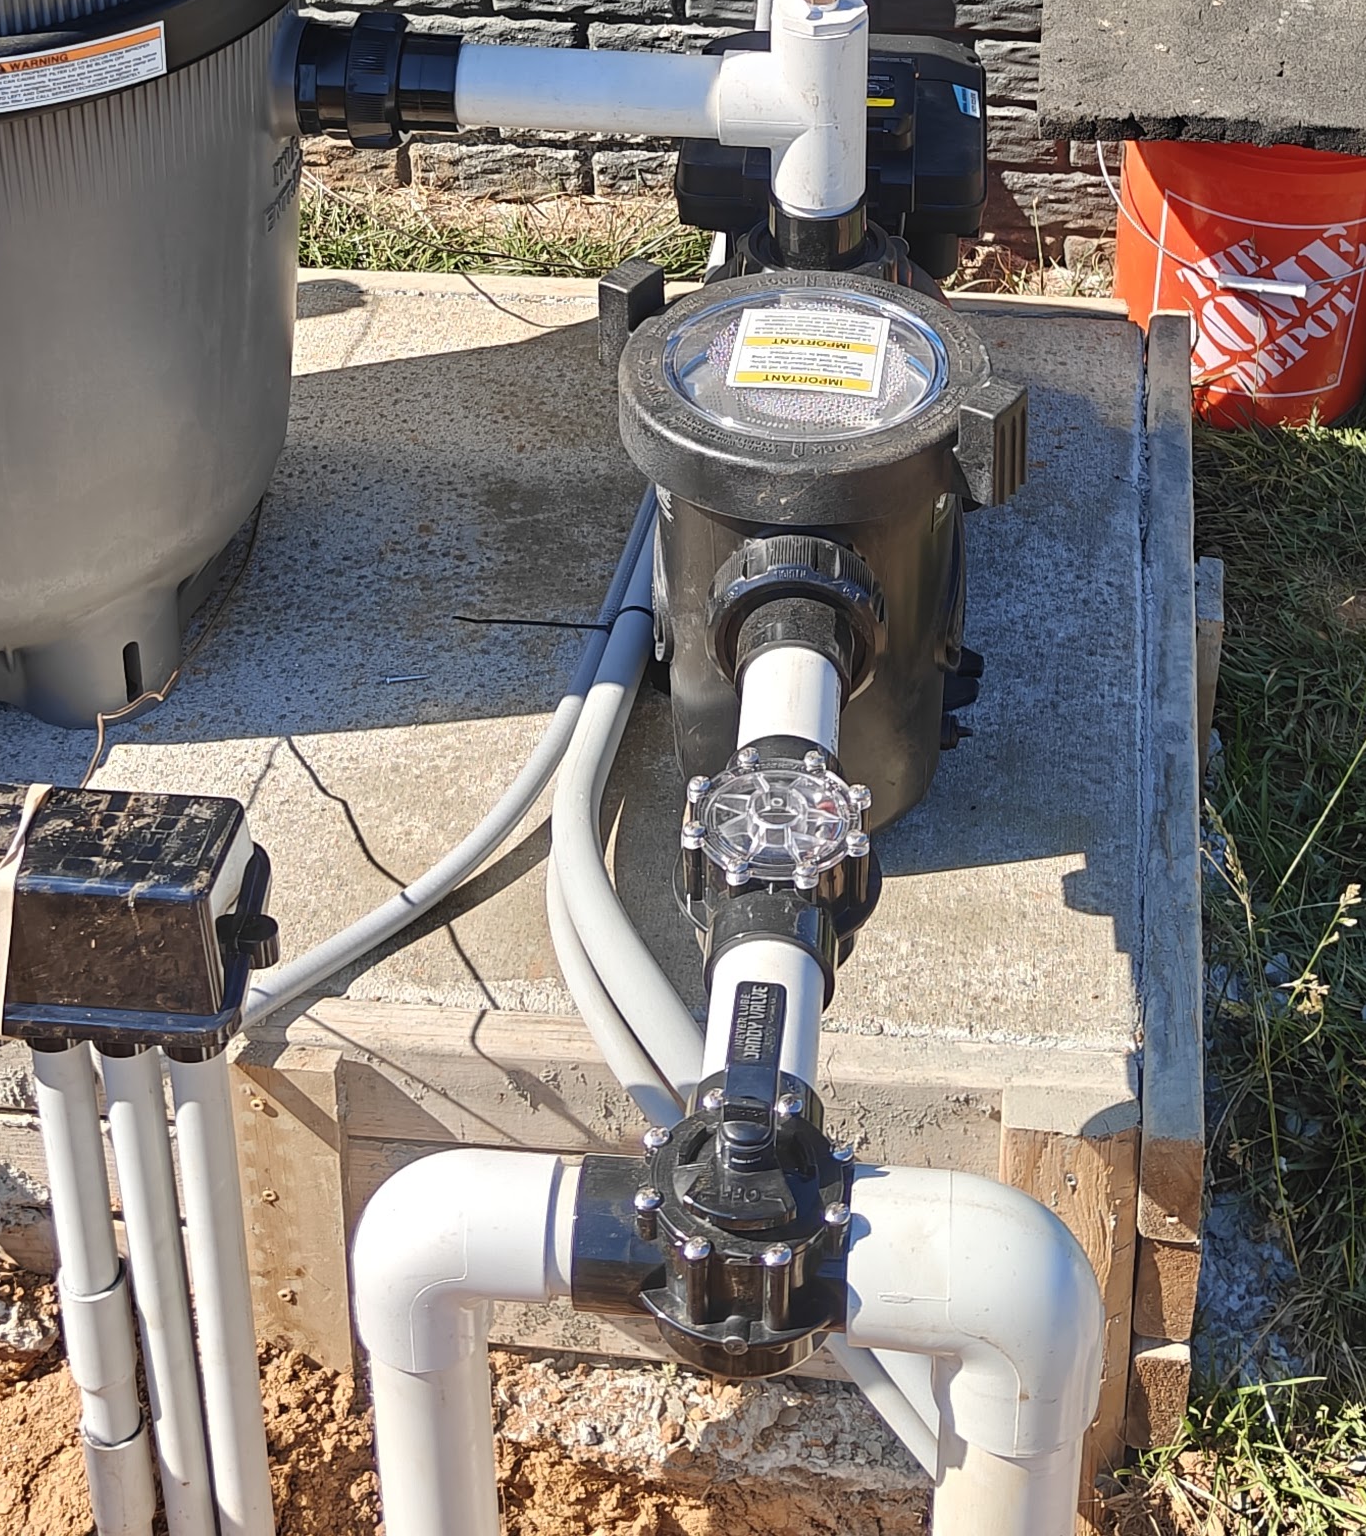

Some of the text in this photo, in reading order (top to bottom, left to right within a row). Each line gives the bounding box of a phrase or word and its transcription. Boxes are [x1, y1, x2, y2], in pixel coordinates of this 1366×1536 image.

[10, 54, 69, 71] WARNING
[756, 276, 799, 287] LOCK
[1176, 239, 1270, 299] THE
[771, 338, 850, 350] IMPORTANT
[1225, 286, 1355, 396] DEPOT
[763, 374, 843, 386] IMPORTANT
[734, 992, 751, 1049] NEVER LUBE
[742, 985, 769, 1060] JANDY VALVE
